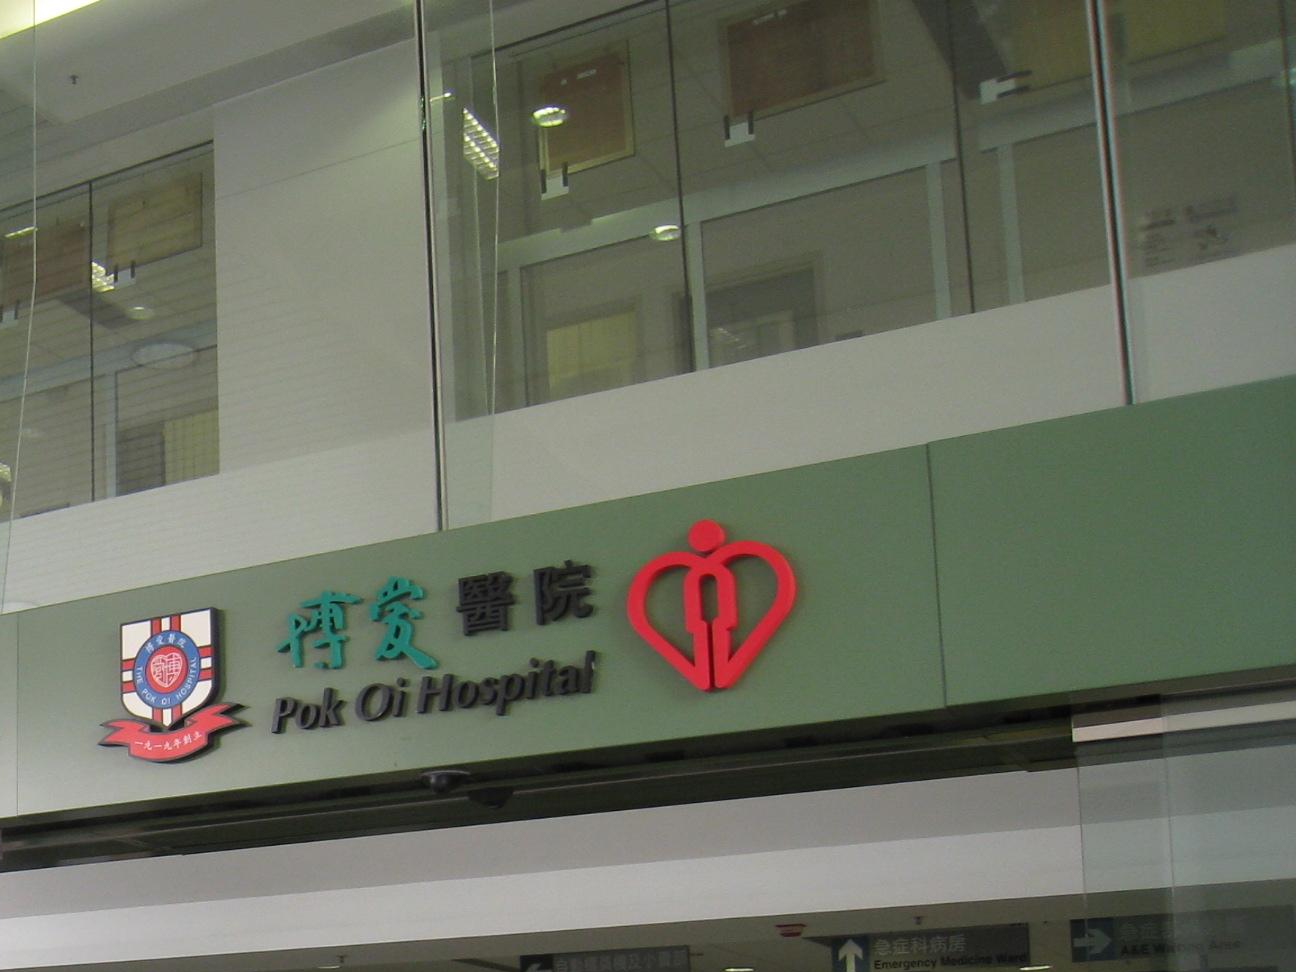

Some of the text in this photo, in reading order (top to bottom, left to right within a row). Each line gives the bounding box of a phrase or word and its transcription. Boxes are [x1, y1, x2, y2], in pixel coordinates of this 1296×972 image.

[276, 560, 595, 669] 博愛醫院
[142, 689, 156, 704] POK
[161, 698, 171, 706] OI
[176, 656, 198, 702] HOSPITAL
[271, 649, 598, 734] Pok Oi Hospital
[134, 730, 203, 751] 一九一九年創立
[874, 934, 968, 956] 急症科病房
[873, 958, 937, 971] Emergency
